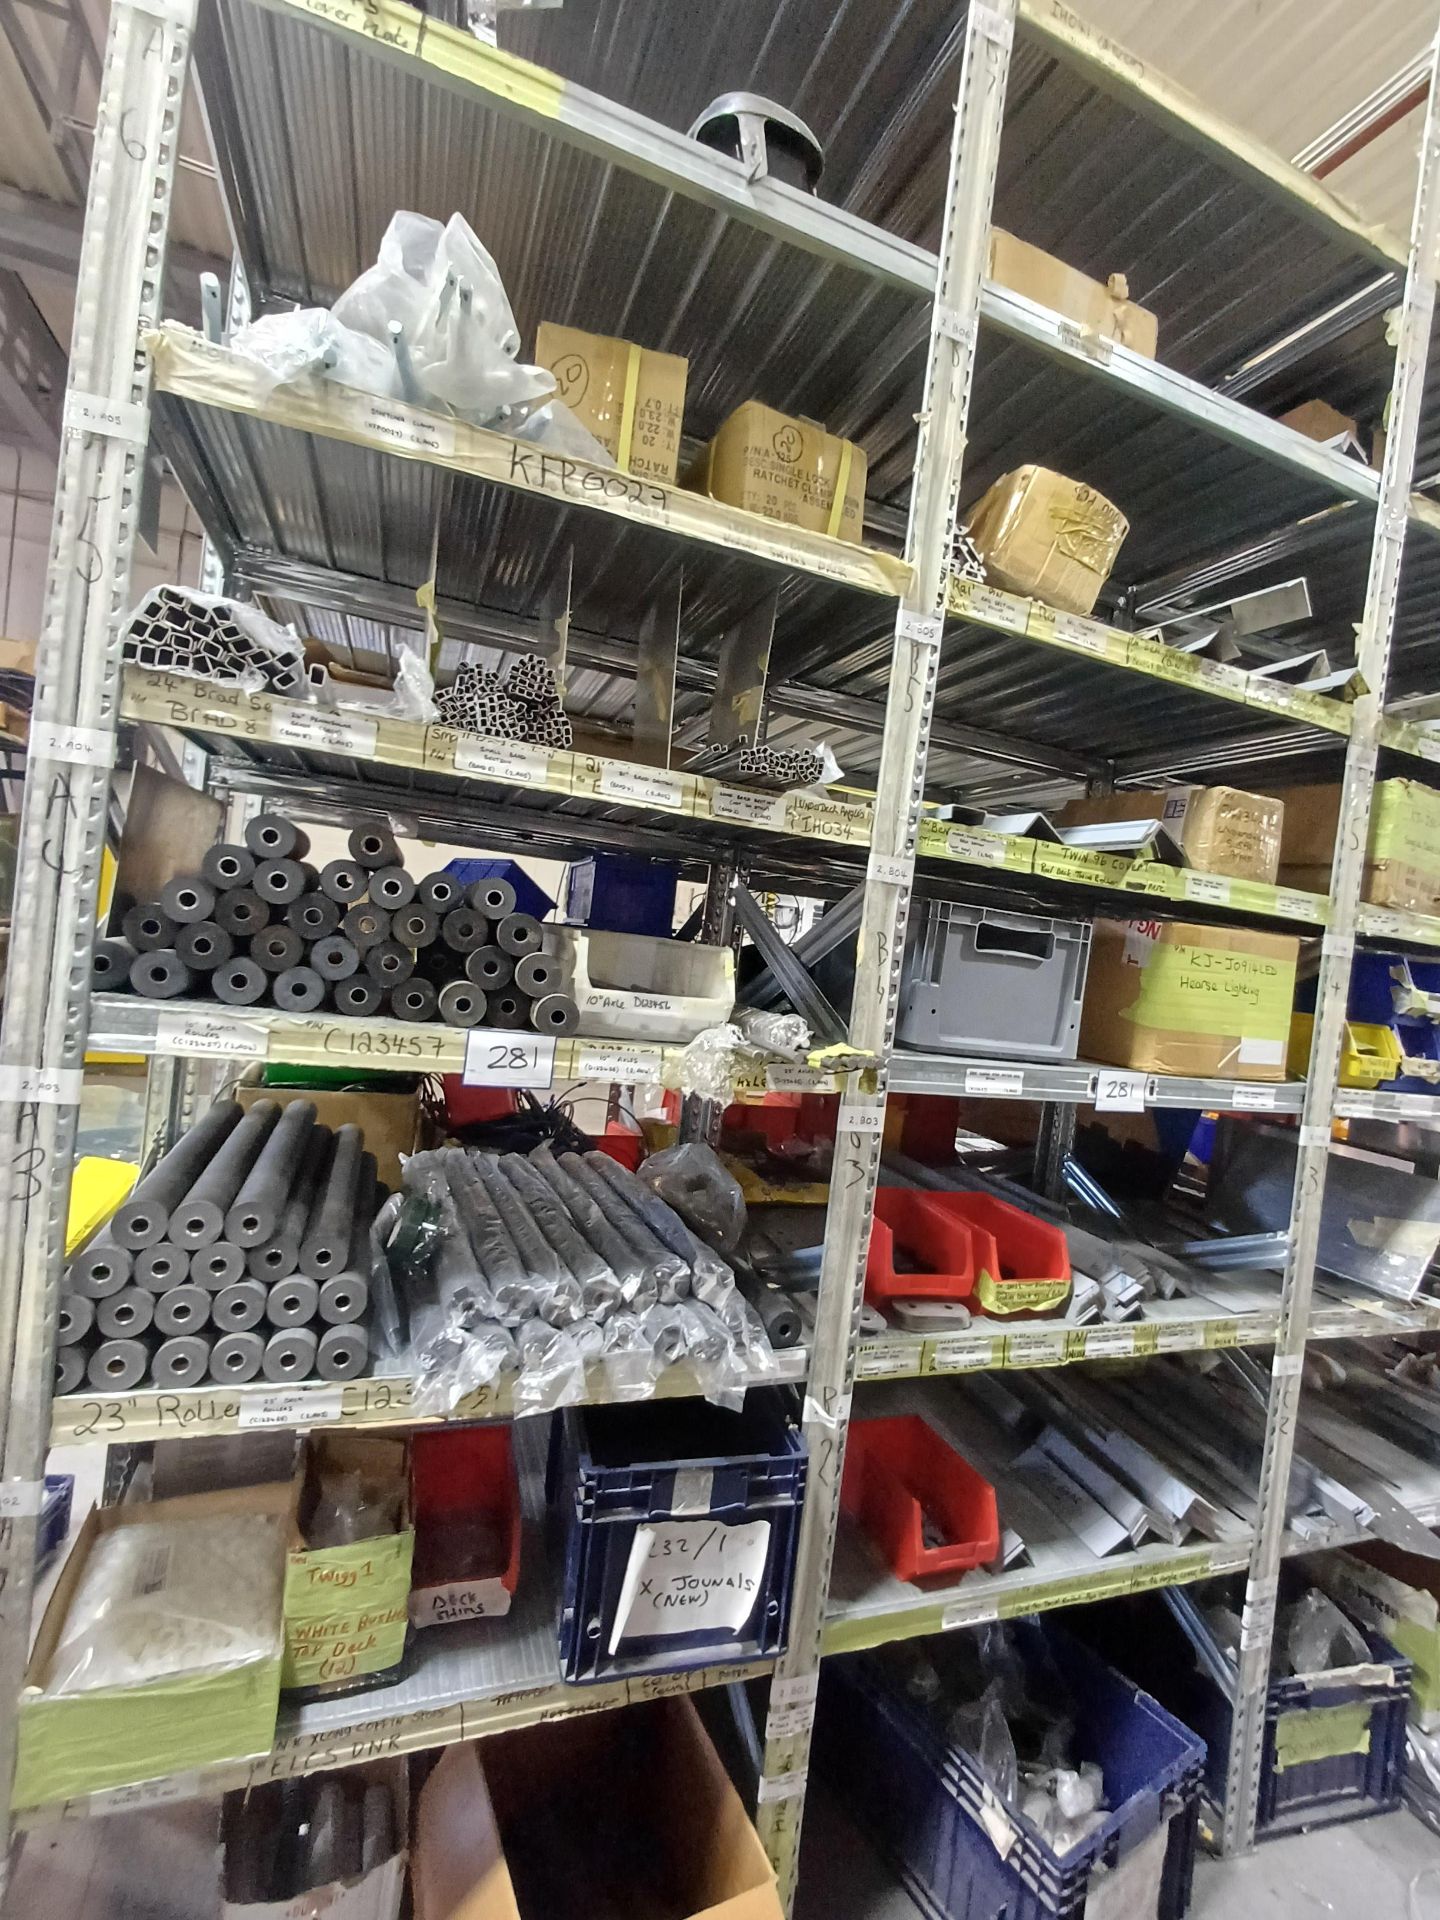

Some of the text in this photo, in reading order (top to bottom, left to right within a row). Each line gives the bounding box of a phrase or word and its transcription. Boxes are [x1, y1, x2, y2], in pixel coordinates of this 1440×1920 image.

[753, 467, 801, 489] RATCHET
[1180, 976, 1218, 993] Hearse
[486, 1045, 539, 1070] 281
[1106, 1080, 1134, 1099] 281
[295, 1621, 350, 1640] WHITE
